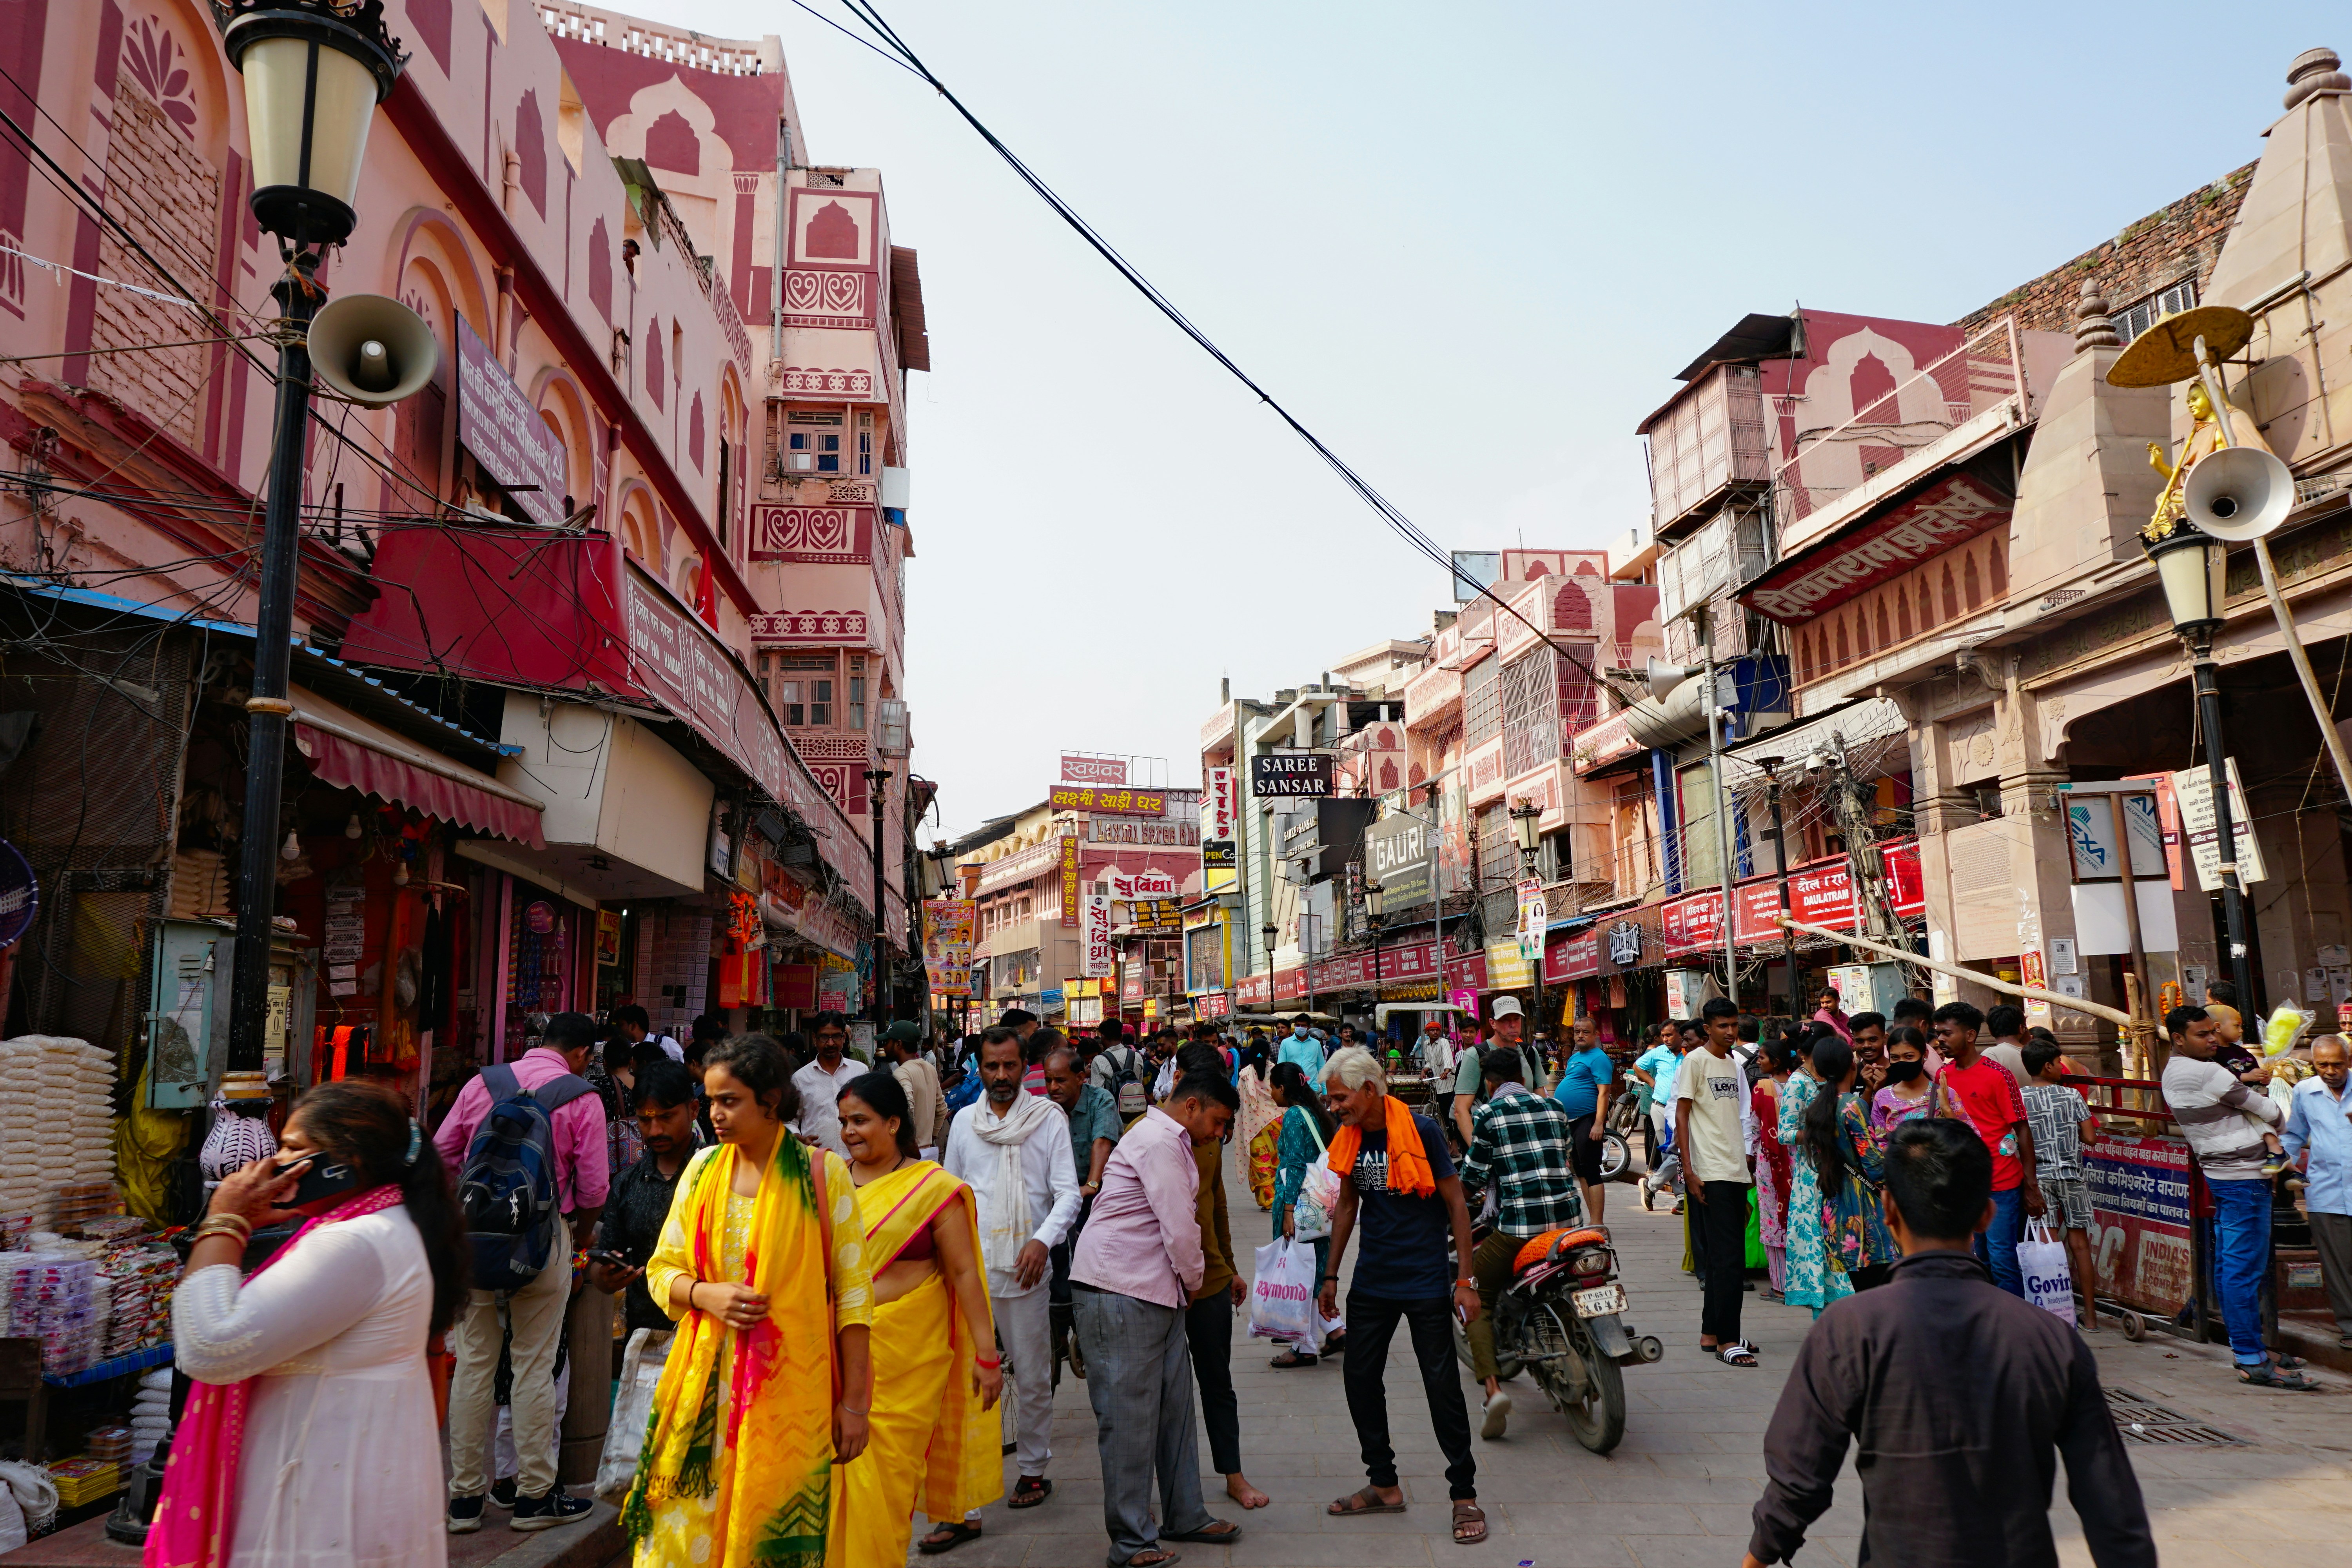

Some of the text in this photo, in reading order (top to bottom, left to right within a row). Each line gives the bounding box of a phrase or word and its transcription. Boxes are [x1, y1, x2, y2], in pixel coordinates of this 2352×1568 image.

[461, 350, 474, 390] भारत
[474, 366, 484, 401] की
[485, 356, 528, 423] कार्यालय
[461, 389, 499, 445] COMMUNIST
[500, 433, 519, 466] PARTY
[520, 457, 526, 474] OF
[471, 429, 497, 472] जिला
[650, 611, 659, 635] पान
[636, 628, 648, 652] DILIP
[651, 639, 660, 661] PAN
[1063, 760, 1124, 779] स्वयंवर
[1262, 758, 1317, 772] SAREE
[1257, 779, 1325, 793] SANSAR
[1053, 788, 1161, 811] लक्ष्मी साड़ी घर
[1284, 816, 1316, 841] SAREE SANSAR
[2125, 805, 2153, 830] ALUMINIUM
[1097, 820, 1200, 845] Laxmi Saree Gha
[2133, 818, 2157, 841] TECHNOLOGY
[2133, 826, 2163, 853] www.anexagro
[2190, 834, 2206, 843] मंदिर
[1377, 824, 1424, 871] GAURI
[2072, 821, 2105, 866] EXA
[2084, 857, 2099, 872] PANEL
[1114, 876, 1172, 898] सुविधा
[1390, 885, 1401, 894] Designer
[1419, 887, 1430, 896] Material
[1804, 889, 1849, 906] DAULATRAM
[927, 901, 947, 909] भोजपुरी
[1700, 914, 1715, 924] CORER
[1611, 934, 1624, 958] PIZZA
[1410, 960, 1419, 970] SAREE
[1503, 961, 1518, 973] Vishwanath
[773, 972, 787, 982] HUR
[2095, 1143, 2104, 1153] चार
[2105, 1140, 2122, 1156] पहिया
[2123, 1145, 2138, 1159] वाहन
[2139, 1149, 2152, 1163] खड़ा
[2152, 1150, 2167, 1163] करना
[2107, 1167, 2156, 1193] कमिश्नरेट
[2158, 1180, 2190, 1199] वाराण
[2121, 1193, 2146, 1211] नियमों
[2147, 1201, 2158, 1213] का
[2160, 1204, 2183, 1220] पालन
[2146, 1240, 2189, 1266] INDIA'S
[1256, 1280, 1307, 1302] Raymond
[2028, 1273, 2072, 1294] Govin
[2047, 1295, 2071, 1304] Readymade
